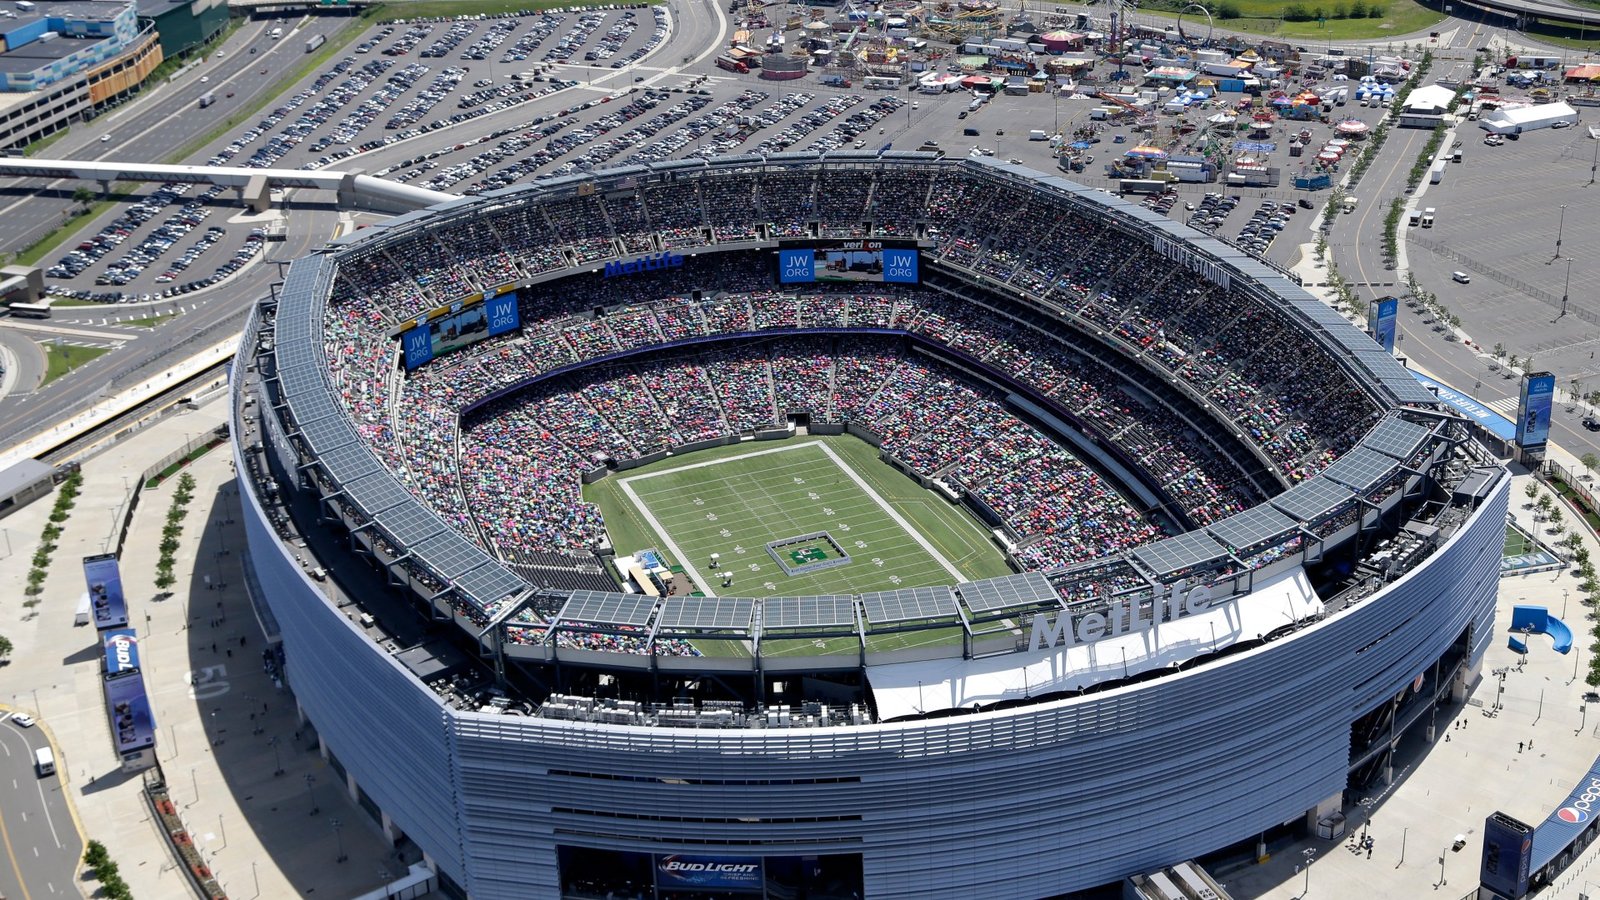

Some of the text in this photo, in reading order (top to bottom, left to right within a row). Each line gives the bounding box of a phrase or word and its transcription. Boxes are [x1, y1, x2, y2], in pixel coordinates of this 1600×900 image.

[604, 250, 684, 278] MetLife
[786, 256, 808, 268] JW
[889, 256, 912, 267] JW
[1153, 234, 1231, 292] METLIFE STADIUM
[784, 268, 809, 277] .ORG
[888, 268, 912, 277] .ORG
[493, 301, 512, 319] JW
[492, 315, 514, 329] .ORG
[410, 333, 426, 352] JW
[1028, 578, 1213, 655] MetLife
[183, 664, 231, 700] 50
[666, 861, 758, 873] BUD LIGHT
